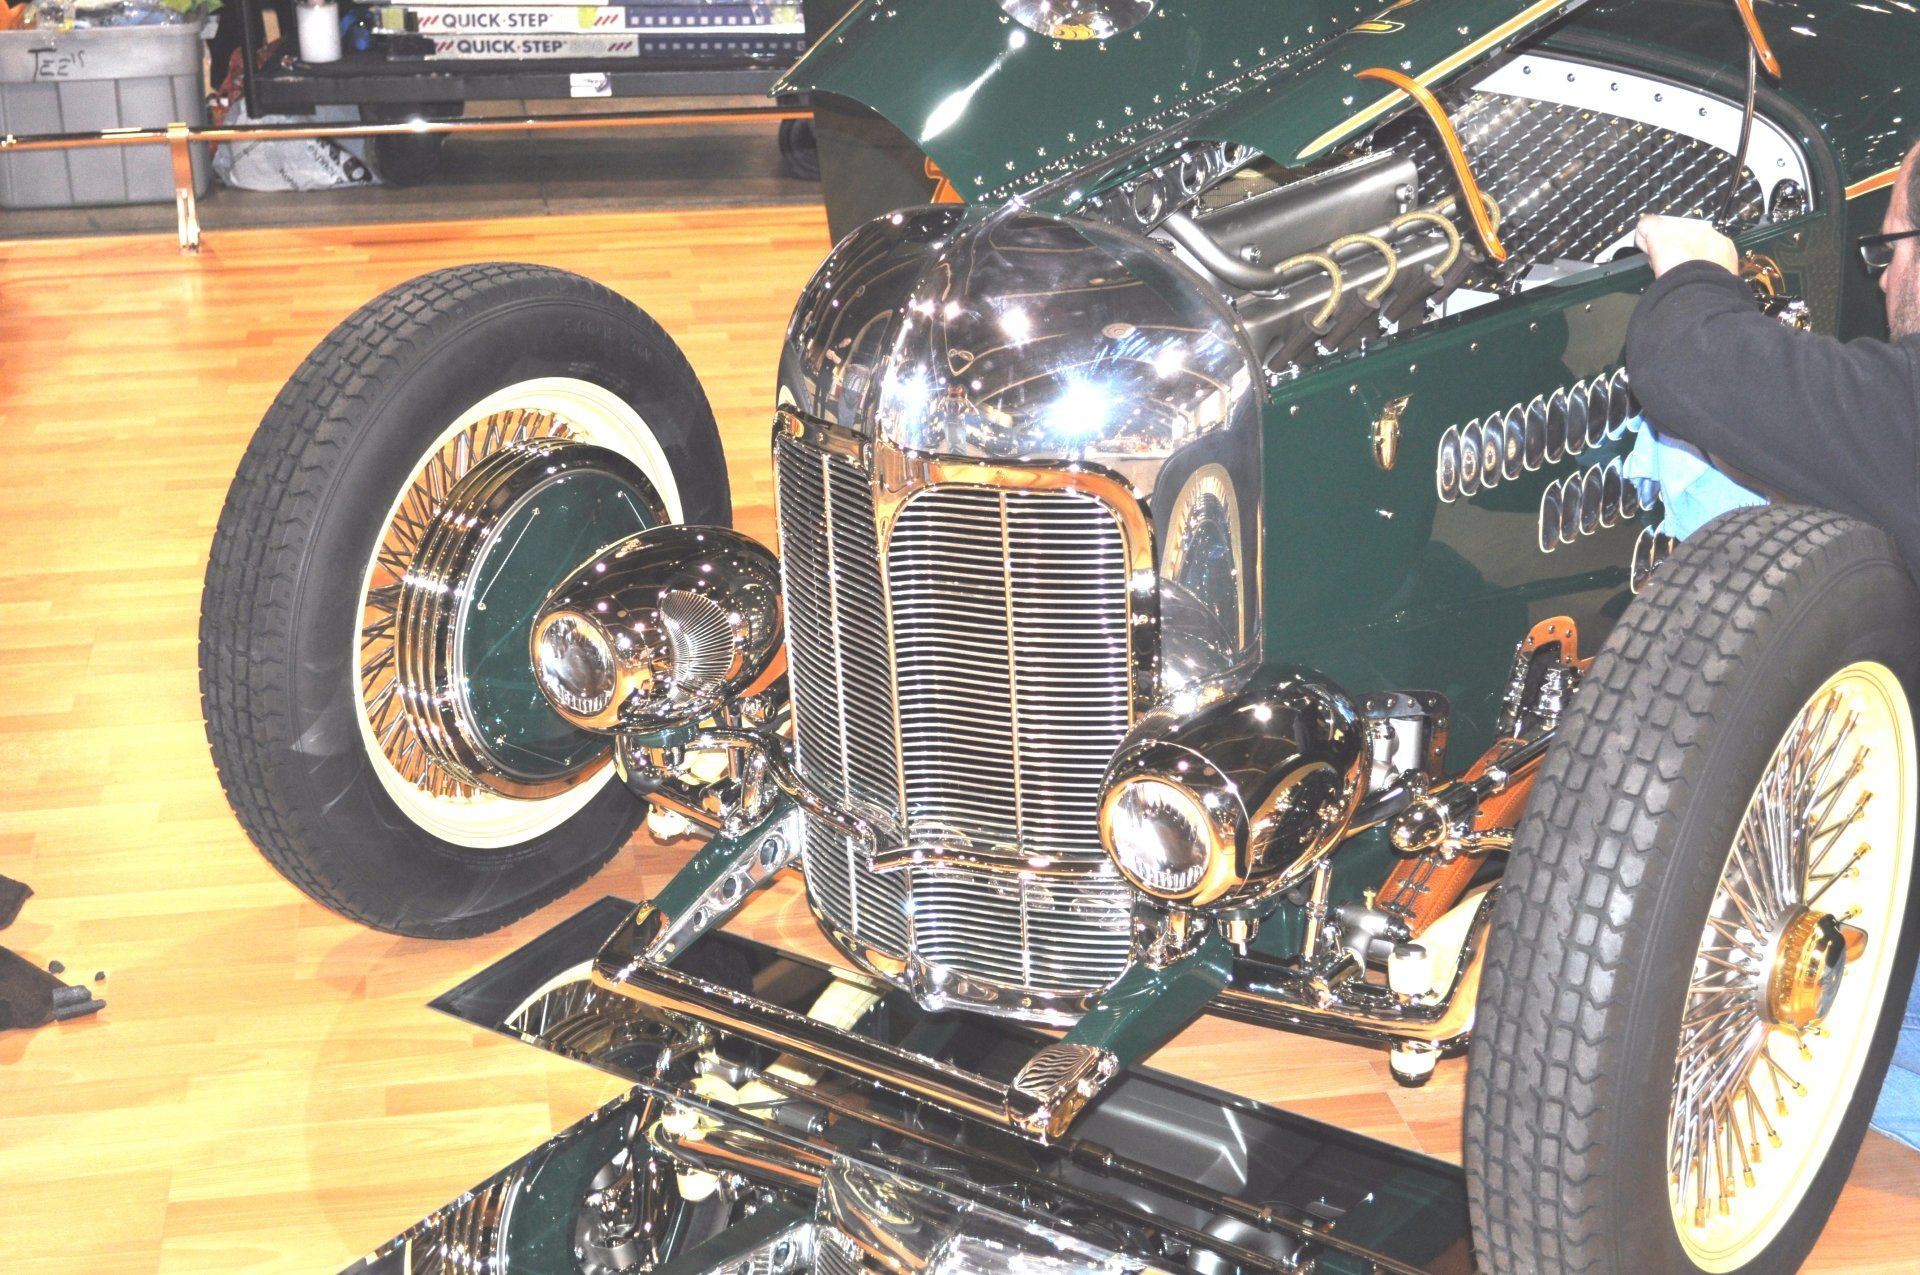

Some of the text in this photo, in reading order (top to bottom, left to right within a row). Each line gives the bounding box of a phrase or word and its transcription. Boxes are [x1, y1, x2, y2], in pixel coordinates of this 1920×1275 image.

[442, 13, 549, 28] QUICK STEP
[457, 40, 515, 54] QUICK
[522, 40, 563, 53] STEP
